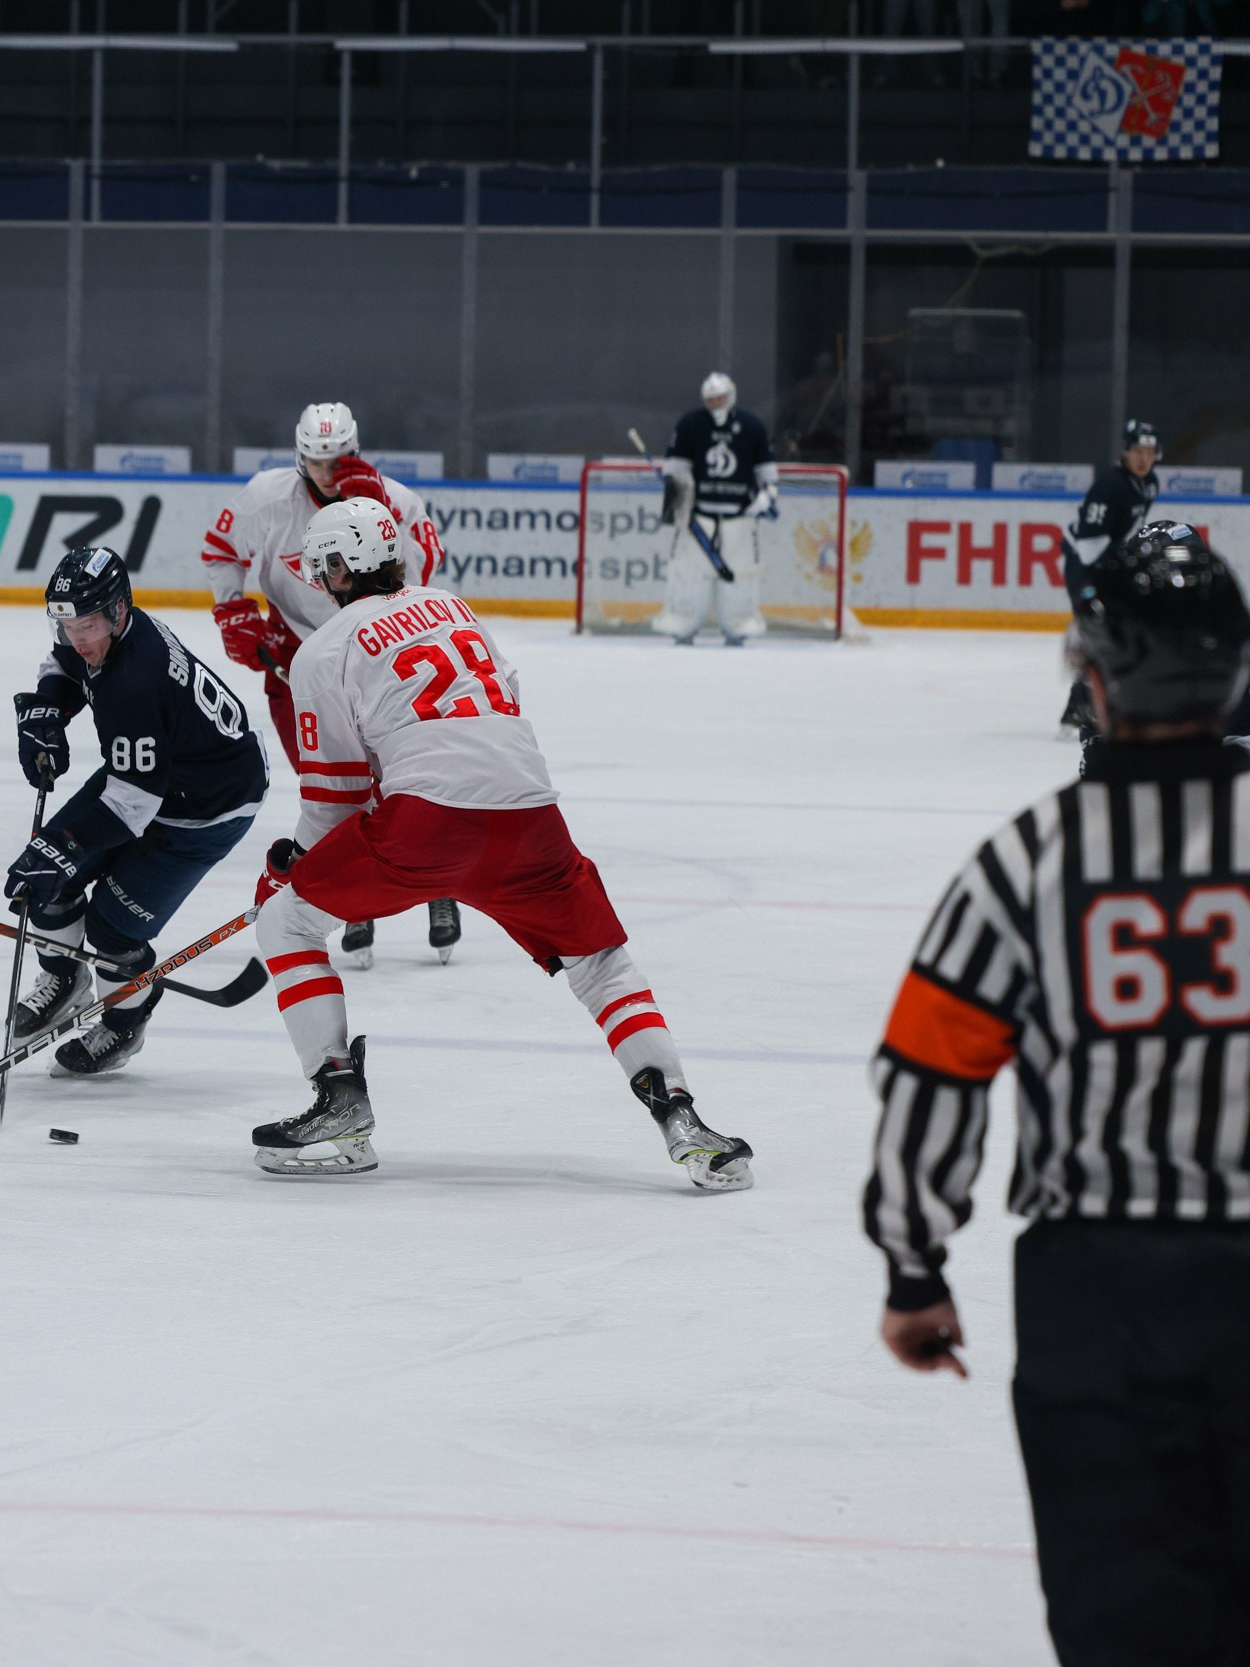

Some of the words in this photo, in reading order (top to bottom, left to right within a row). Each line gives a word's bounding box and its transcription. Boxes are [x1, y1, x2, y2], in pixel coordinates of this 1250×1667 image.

[216, 508, 235, 534] 8
[377, 519, 397, 541] 28
[318, 540, 337, 549] CCM
[54, 578, 72, 592] 86
[218, 611, 260, 630] CCM
[357, 599, 456, 657] GAVRILOV
[391, 629, 521, 721] 28
[17, 706, 60, 724] UER
[299, 711, 319, 752] 8
[111, 735, 156, 773] 86
[30, 837, 78, 878] BAUE
[25, 932, 120, 972] TRUE
[135, 939, 214, 991] HZRDUS
[218, 922, 239, 941] PX
[1081, 887, 1250, 1031] 63
